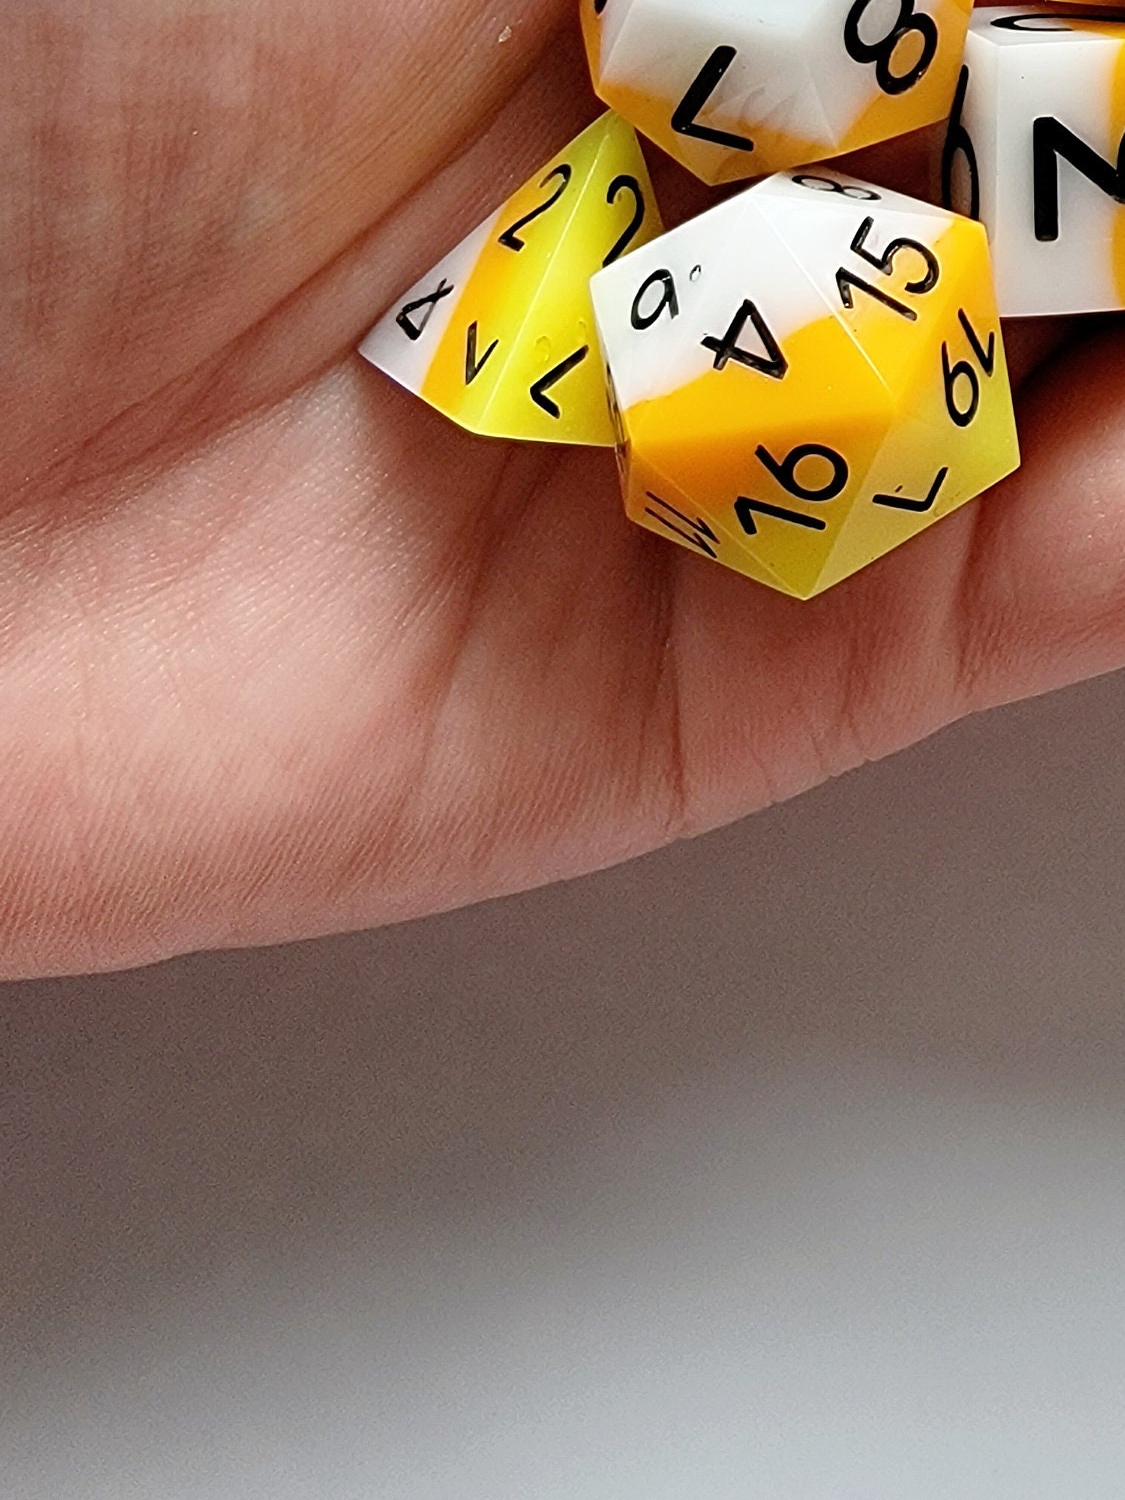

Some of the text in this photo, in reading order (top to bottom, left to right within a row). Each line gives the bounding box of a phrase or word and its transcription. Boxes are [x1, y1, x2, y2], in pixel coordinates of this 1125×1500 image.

[497, 163, 572, 252] 2
[601, 174, 647, 268] 2
[791, 174, 883, 202] 8
[395, 277, 455, 341] 4
[835, 216, 940, 321] 15
[701, 299, 789, 380] 4
[733, 443, 849, 536] 16
